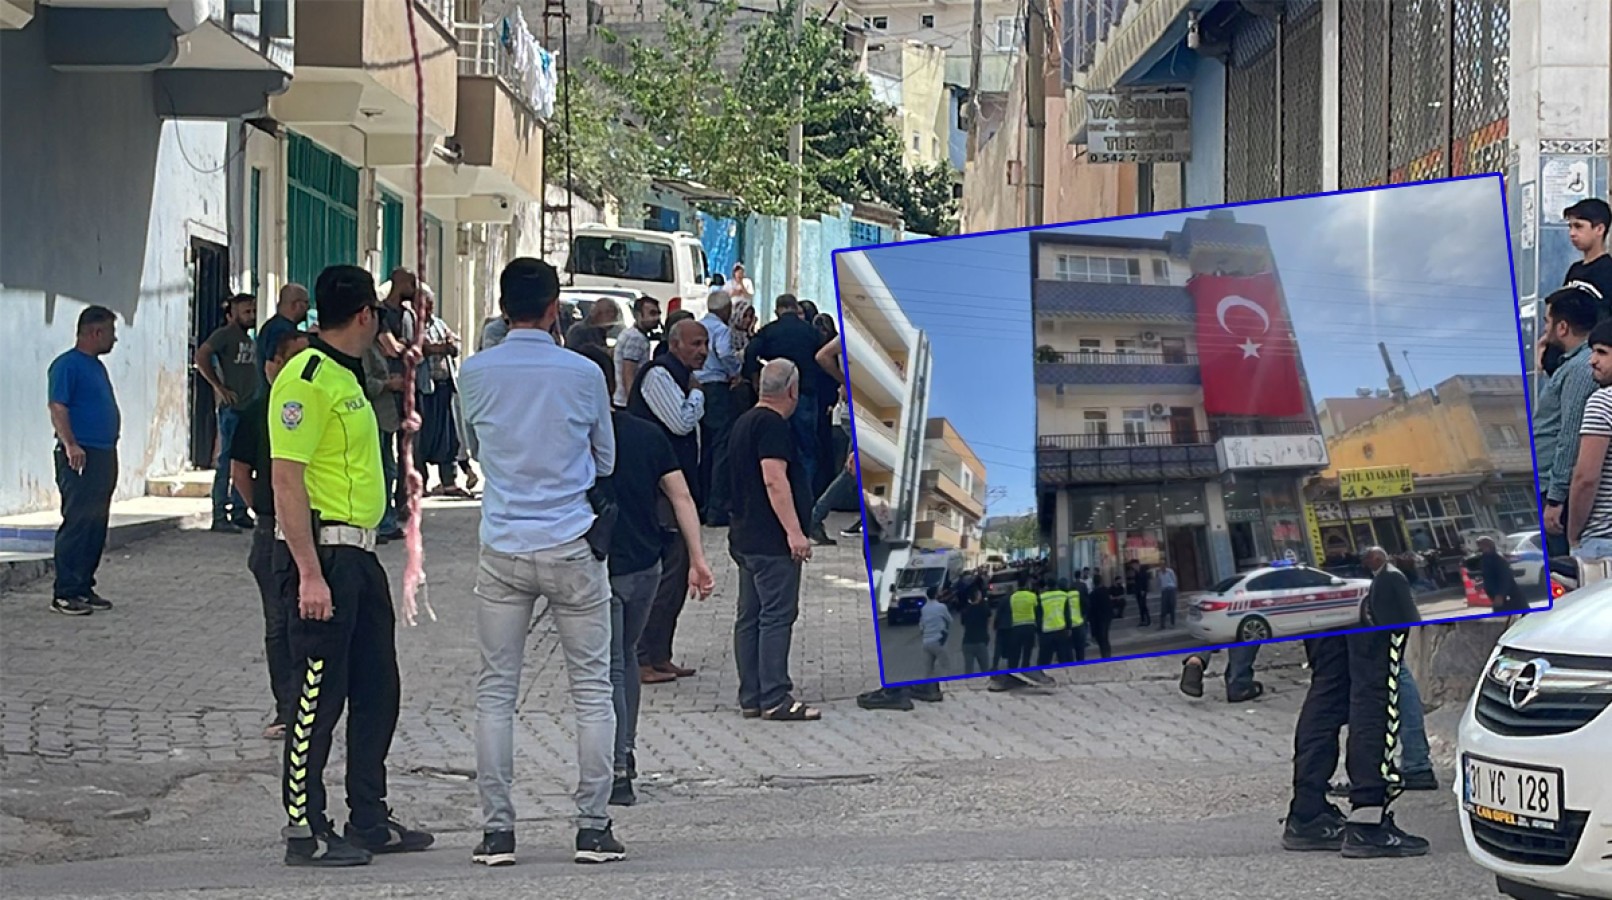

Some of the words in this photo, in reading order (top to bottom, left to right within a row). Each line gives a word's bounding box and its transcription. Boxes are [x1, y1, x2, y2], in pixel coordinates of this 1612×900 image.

[1090, 153, 1098, 162] 0
[1103, 153, 1125, 162] 542
[1471, 764, 1481, 799] 31
[1488, 769, 1507, 806] YC
[1518, 774, 1550, 813] 128
[1492, 809, 1517, 825] OPEL
